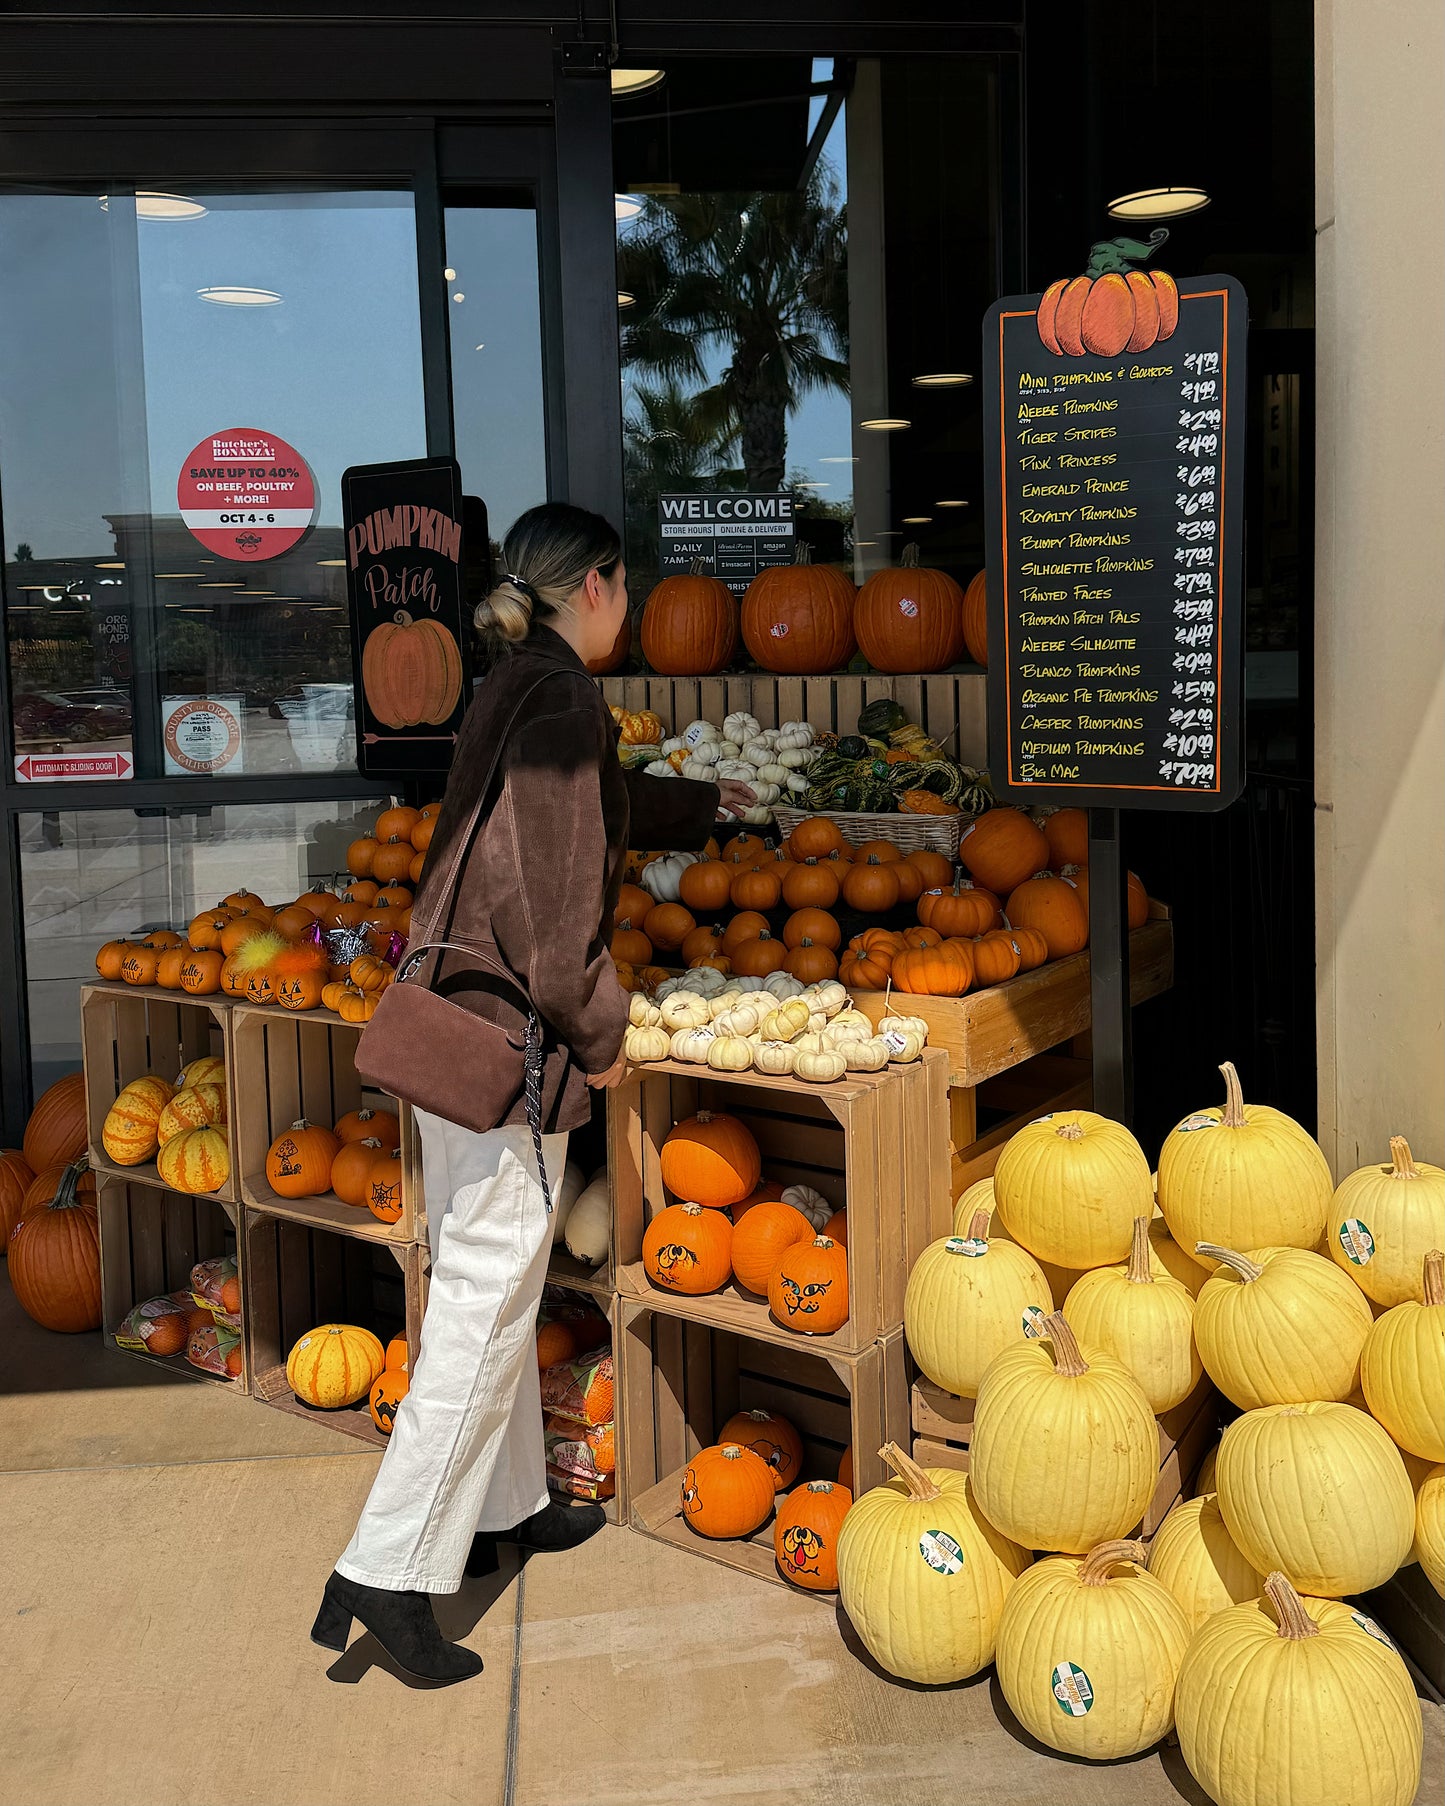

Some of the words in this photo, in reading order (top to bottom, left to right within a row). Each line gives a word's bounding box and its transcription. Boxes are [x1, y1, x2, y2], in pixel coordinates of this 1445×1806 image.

[1019, 372, 1047, 390] MINI
[1053, 371, 1113, 386] PUMPKINS
[1129, 366, 1173, 380] GOURDS
[1018, 403, 1059, 419] WEEBE
[1064, 400, 1118, 415] PUMPKINS
[212, 439, 269, 448] Butcher's
[1017, 429, 1056, 445] TIGER
[1065, 427, 1117, 441] STRIPES
[213, 449, 275, 457] BONANZA!
[1020, 456, 1051, 470] PINK
[1058, 454, 1117, 469] PRINCESS
[190, 468, 224, 478] SAVE
[227, 468, 246, 478] UP
[250, 468, 265, 478] TO
[269, 468, 299, 478] 40%
[196, 483, 213, 491] ON
[216, 483, 244, 492] BEEF,
[246, 482, 295, 491] POULTRY
[1022, 484, 1080, 497] EMERALD
[1084, 479, 1130, 494] PRINCE
[233, 495, 270, 504] MORE!
[661, 499, 792, 519] WELCOME
[1020, 509, 1077, 524] ROYALTY
[1080, 506, 1137, 520] PUMPKINS
[220, 514, 245, 523] OCT
[248, 514, 256, 523] 4
[267, 514, 275, 523] 6
[688, 526, 712, 534] HOURS
[755, 525, 787, 533] DELIVERY
[349, 505, 462, 571] PUMPKIN
[1020, 536, 1066, 550] BUMPY
[1069, 533, 1131, 548] PUMPKINS
[673, 544, 703, 552] DAILY
[763, 543, 786, 551] amazon
[1021, 562, 1093, 576] SILHOUETTE
[1096, 557, 1155, 573] PUMPKINS
[365, 564, 441, 612] Patch
[1020, 587, 1067, 602] PAINTED
[1074, 585, 1113, 600] FACES
[105, 615, 128, 624] ORG
[1020, 612, 1069, 626] PUMPKIN
[1073, 612, 1103, 625] PATCH
[1109, 610, 1140, 624] PALS
[99, 624, 129, 634] HONEY
[1022, 637, 1066, 652] WEEBE
[1071, 637, 1136, 651] SILHOUTTE
[1020, 664, 1072, 678] BLANCO
[1077, 663, 1140, 677] PUMPKINS
[1022, 689, 1068, 704] ORGANIC
[1074, 689, 1092, 703] PIE
[1097, 687, 1159, 702] PUMPKINS
[167, 704, 194, 740] COUNTY
[207, 703, 239, 737] ORANGE
[1021, 715, 1072, 730] CASPER
[1078, 716, 1144, 730] PUMPKINS
[1021, 741, 1070, 754] MEDIUM
[1075, 741, 1144, 755] PUMPKINS
[35, 764, 69, 773] AUTOMATIC
[70, 763, 94, 771] SLIDING
[95, 762, 112, 771] DOOR
[177, 753, 231, 769] CALIFORNIA
[1020, 763, 1046, 778] BIG
[1050, 764, 1080, 778] MAC
